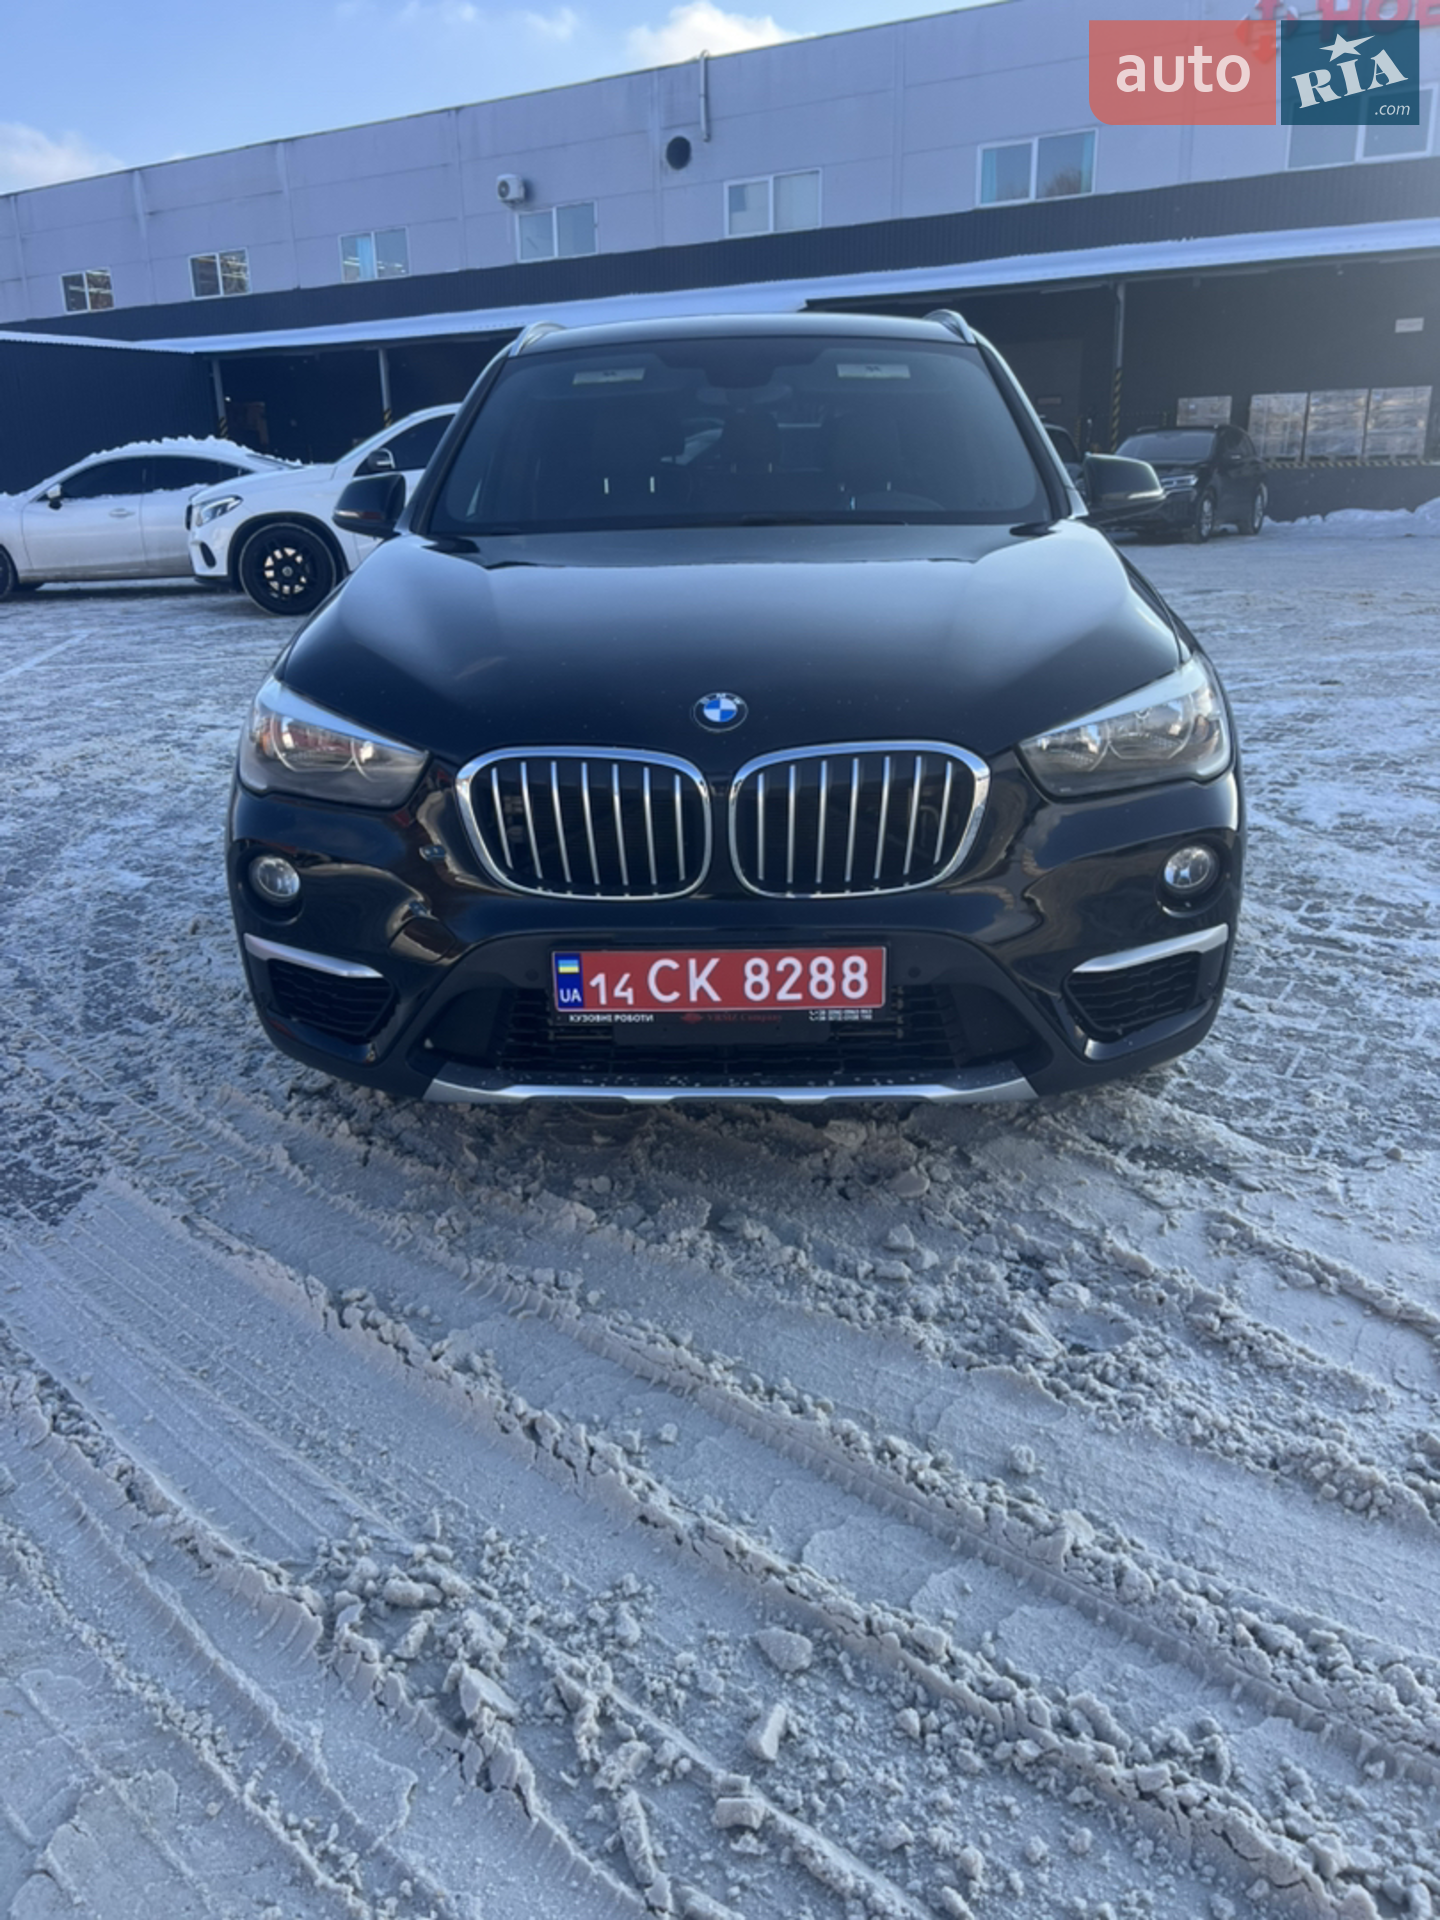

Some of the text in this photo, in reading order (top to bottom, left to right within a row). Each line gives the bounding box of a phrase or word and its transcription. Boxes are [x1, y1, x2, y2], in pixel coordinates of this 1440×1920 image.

[559, 988, 582, 1002] UA
[589, 955, 868, 1005] 14 CK 8288
